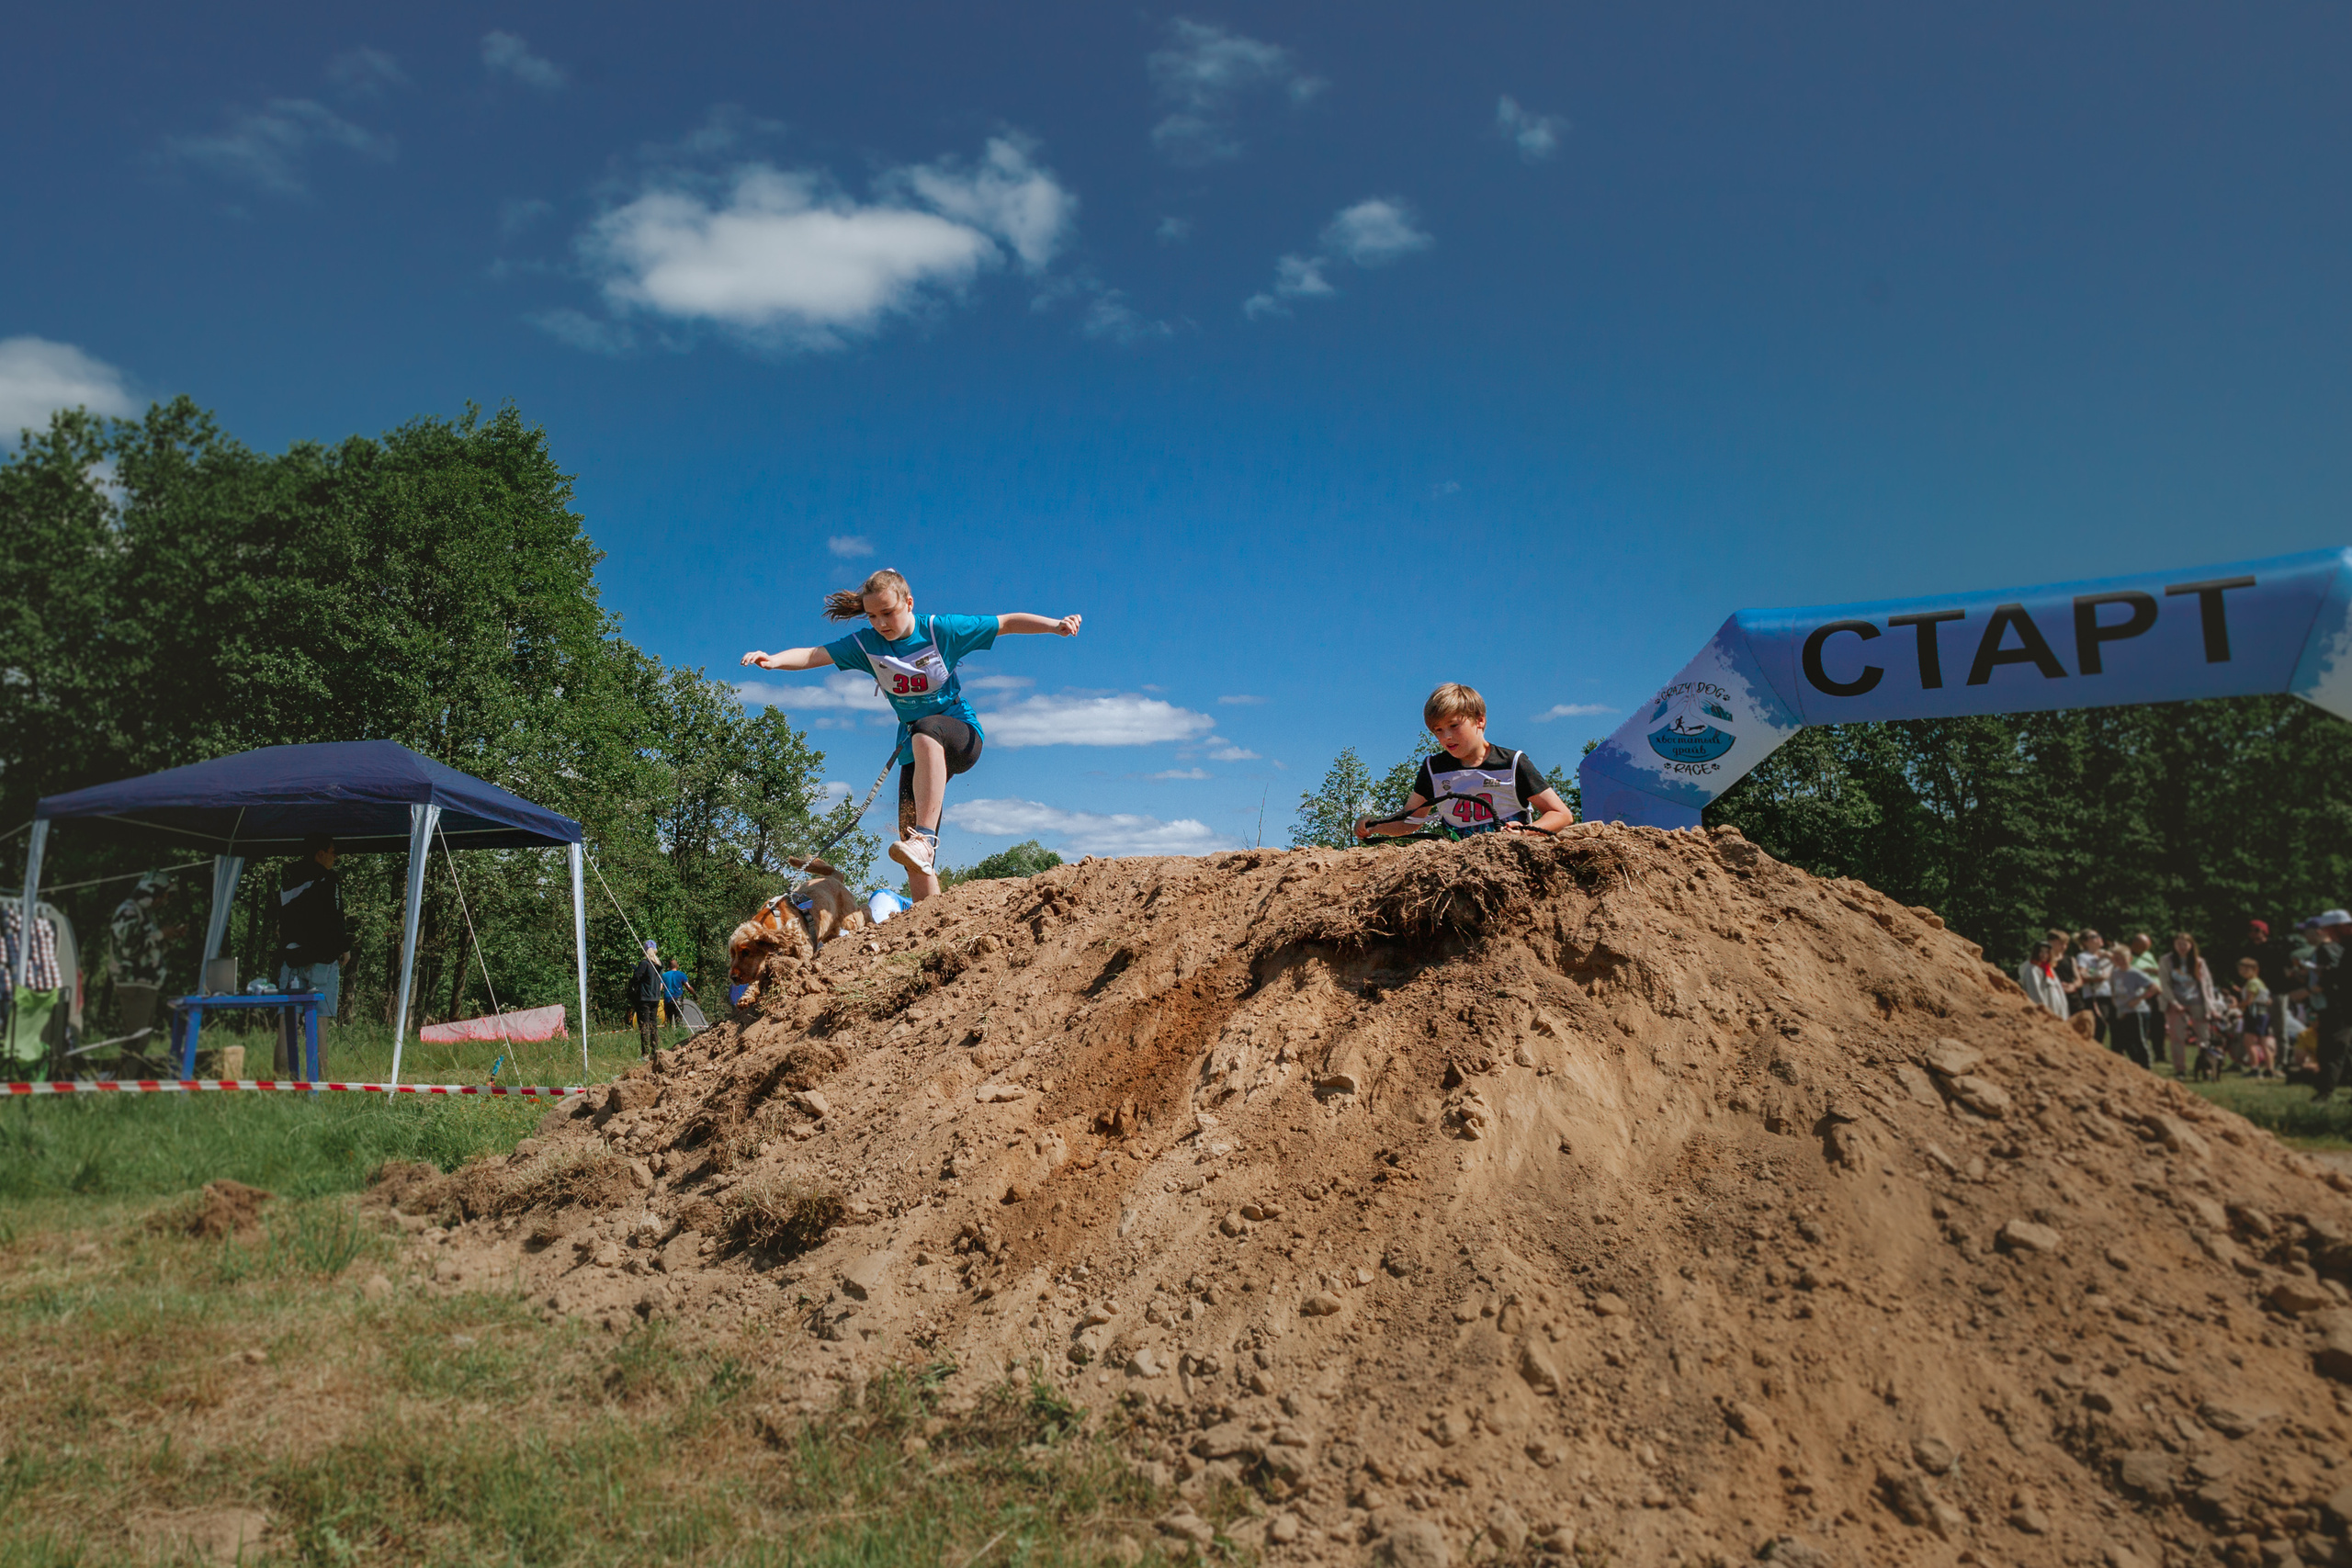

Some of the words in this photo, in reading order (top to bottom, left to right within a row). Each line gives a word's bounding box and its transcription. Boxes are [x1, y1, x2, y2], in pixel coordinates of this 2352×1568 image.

[1801, 575, 2256, 696] СТАРТ
[893, 673, 929, 694] 39
[1661, 682, 1691, 701] CRAZY
[1697, 682, 1725, 698] DOG
[1656, 735, 1721, 745] хвостатый
[1672, 745, 1707, 758] драйв
[1674, 763, 1712, 776] RACE
[1453, 793, 1493, 822] 40
